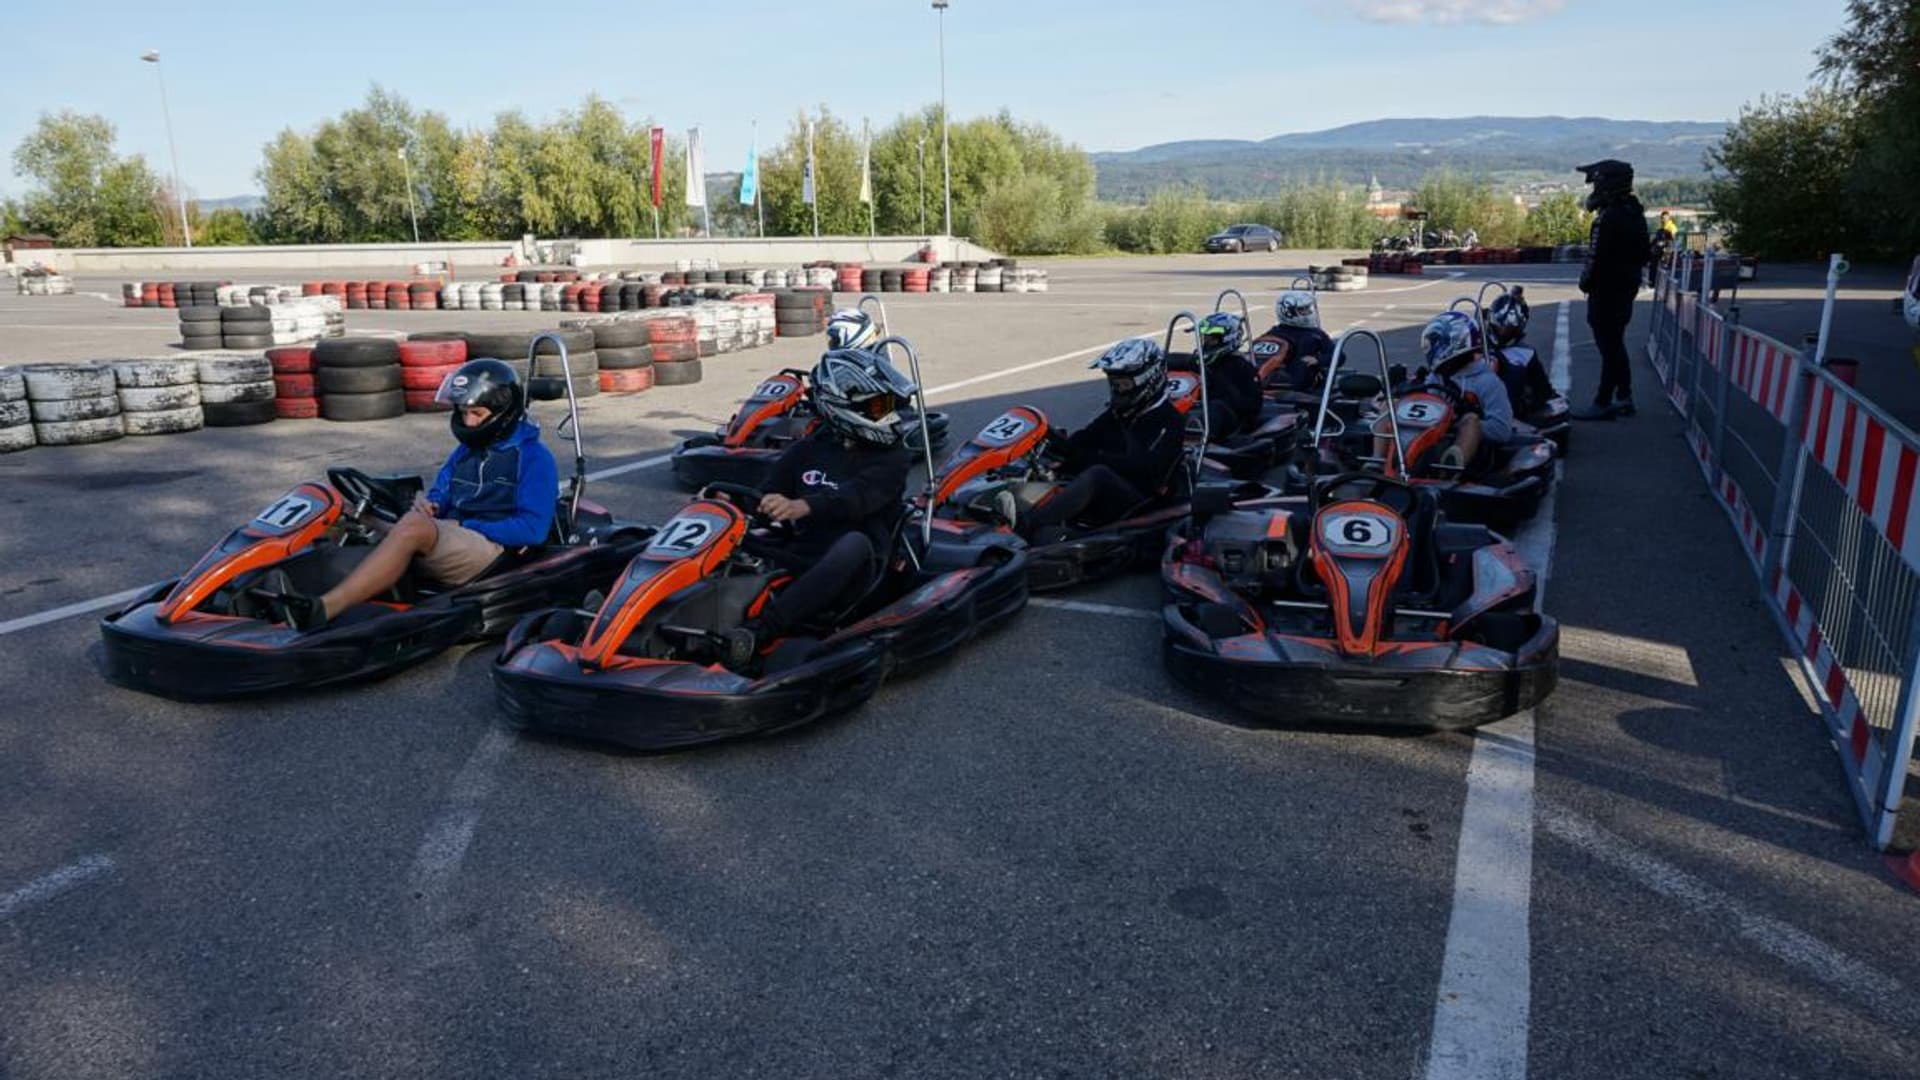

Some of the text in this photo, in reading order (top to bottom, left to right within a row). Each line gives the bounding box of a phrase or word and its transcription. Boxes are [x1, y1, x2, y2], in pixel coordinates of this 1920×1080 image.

[760, 384, 786, 395] 10
[1407, 404, 1428, 418] 5
[986, 418, 1021, 438] 24
[261, 499, 308, 526] 11
[657, 521, 707, 548] 12
[1343, 520, 1372, 543] 6
